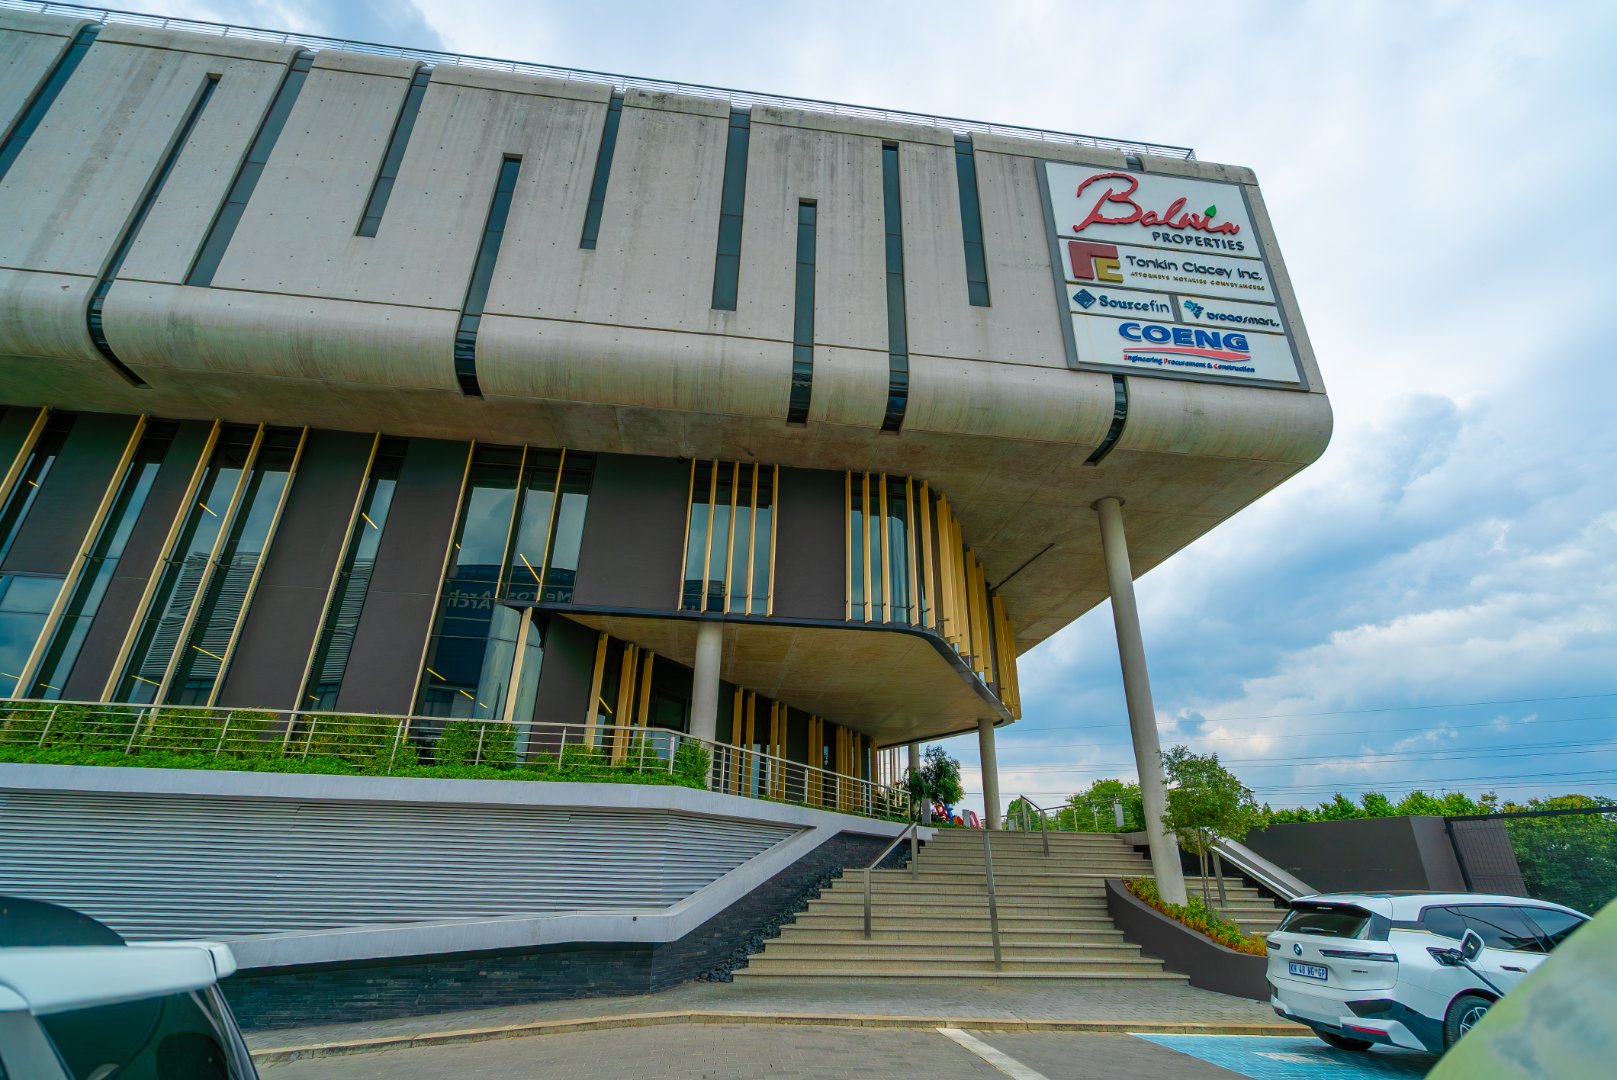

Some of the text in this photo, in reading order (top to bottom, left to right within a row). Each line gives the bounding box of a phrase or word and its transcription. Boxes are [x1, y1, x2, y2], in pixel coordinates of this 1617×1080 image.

[1073, 172, 1241, 234] Balwin
[1152, 231, 1245, 251] PROPERTIES
[1125, 255, 1263, 281] Tonkin Clacey Inc.
[1099, 294, 1170, 314] Sourcefin
[1118, 322, 1250, 352] COENG
[1123, 353, 1163, 365] Engineering
[1163, 357, 1206, 368] Procurement
[1213, 363, 1255, 373] Construction
